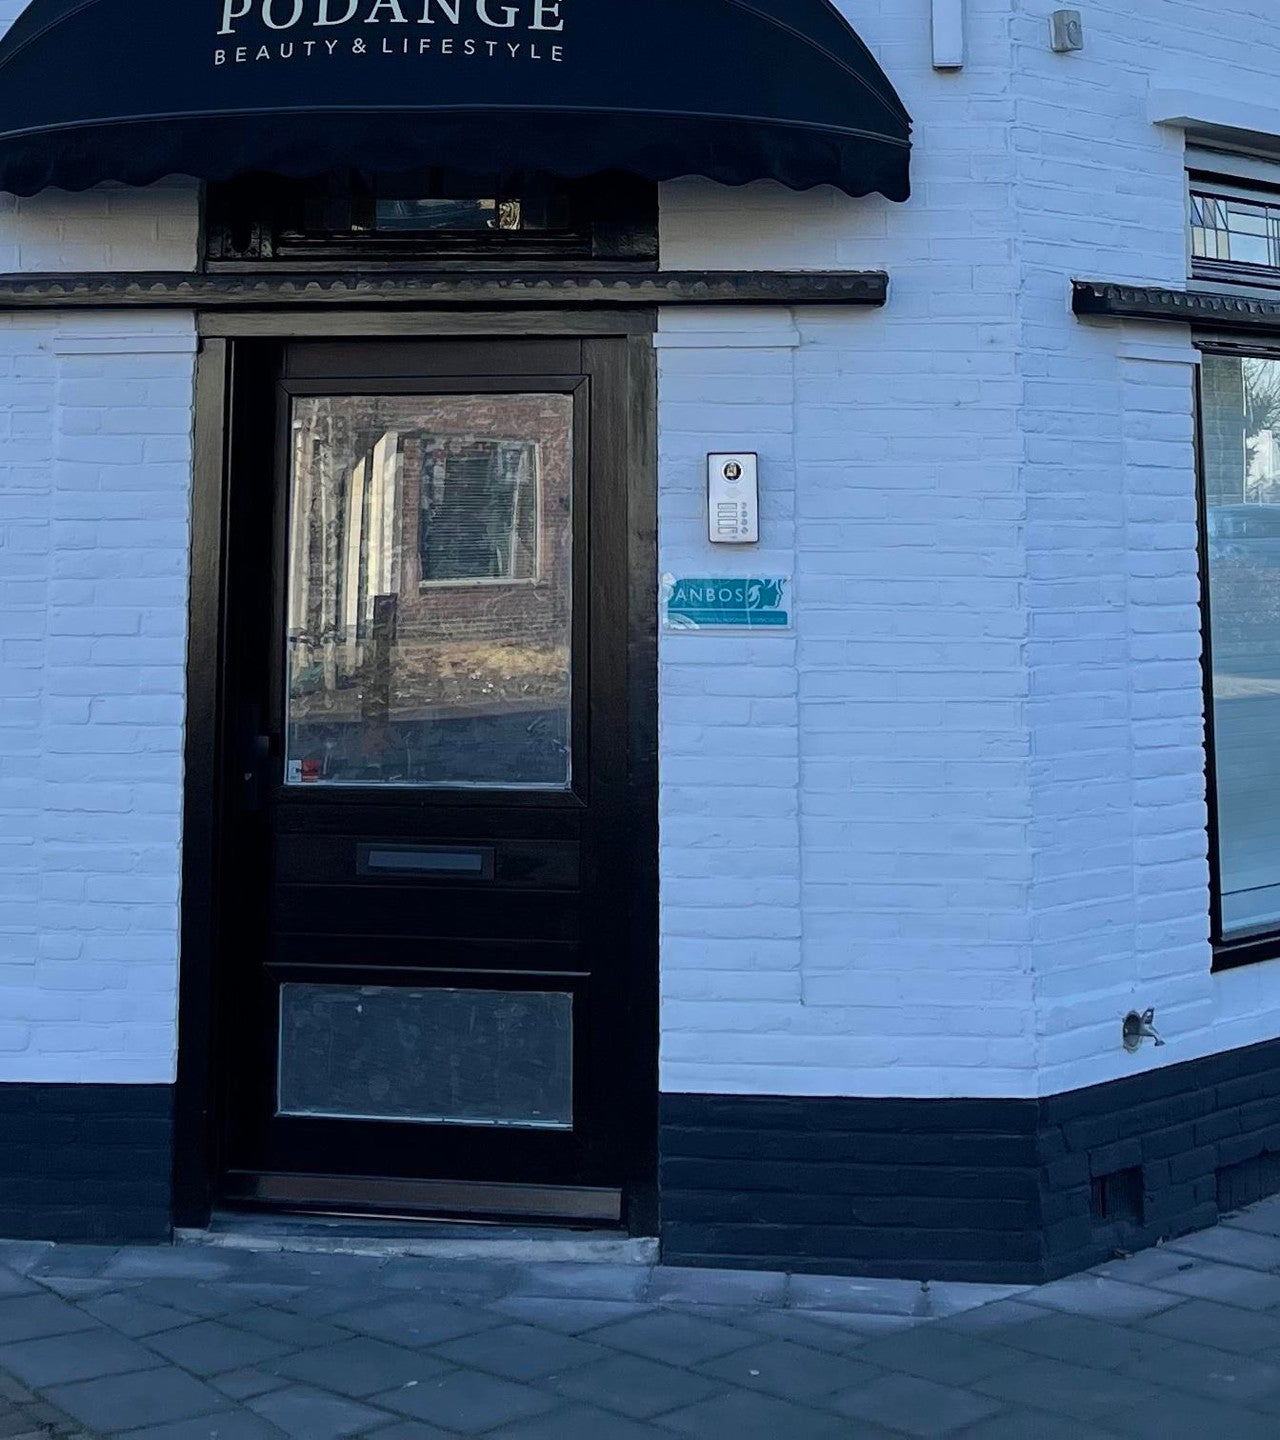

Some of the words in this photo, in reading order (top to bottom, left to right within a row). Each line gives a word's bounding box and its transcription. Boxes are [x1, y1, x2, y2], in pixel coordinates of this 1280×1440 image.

[215, 39, 340, 65] BEAUTY
[351, 38, 368, 54] &
[382, 38, 564, 63] LIFESTYLE
[674, 588, 744, 602] ANBOS
